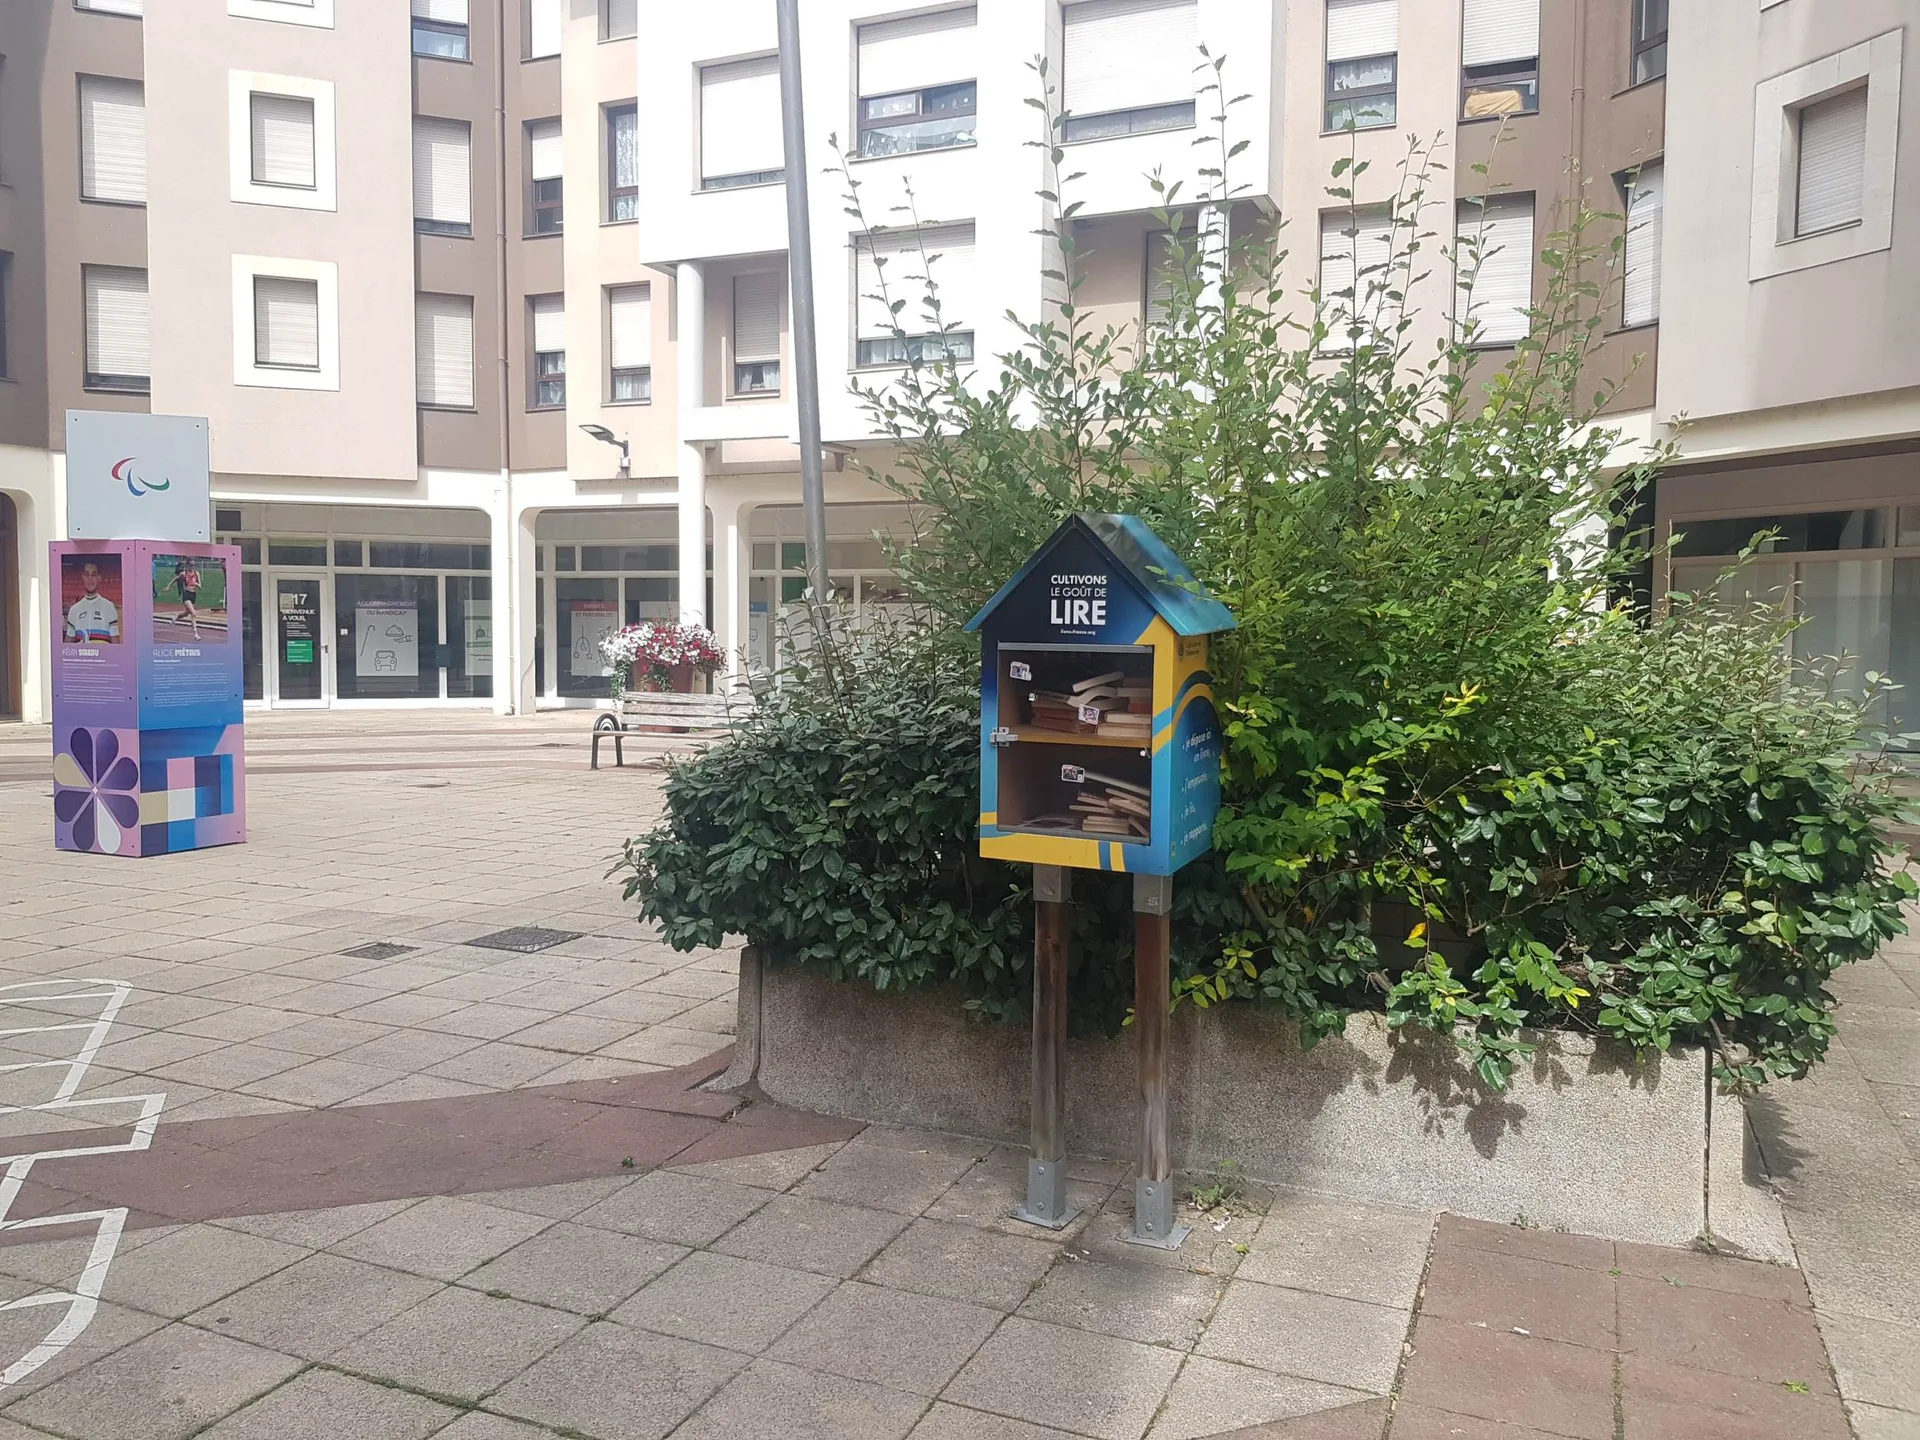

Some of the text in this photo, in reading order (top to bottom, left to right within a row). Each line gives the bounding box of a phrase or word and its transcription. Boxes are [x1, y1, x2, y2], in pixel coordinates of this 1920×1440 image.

[1050, 574, 1107, 585] CULTIVONS
[1050, 585, 1107, 597] LE GOÛT DE
[293, 593, 308, 605] 17
[1050, 599, 1107, 626] LIRE
